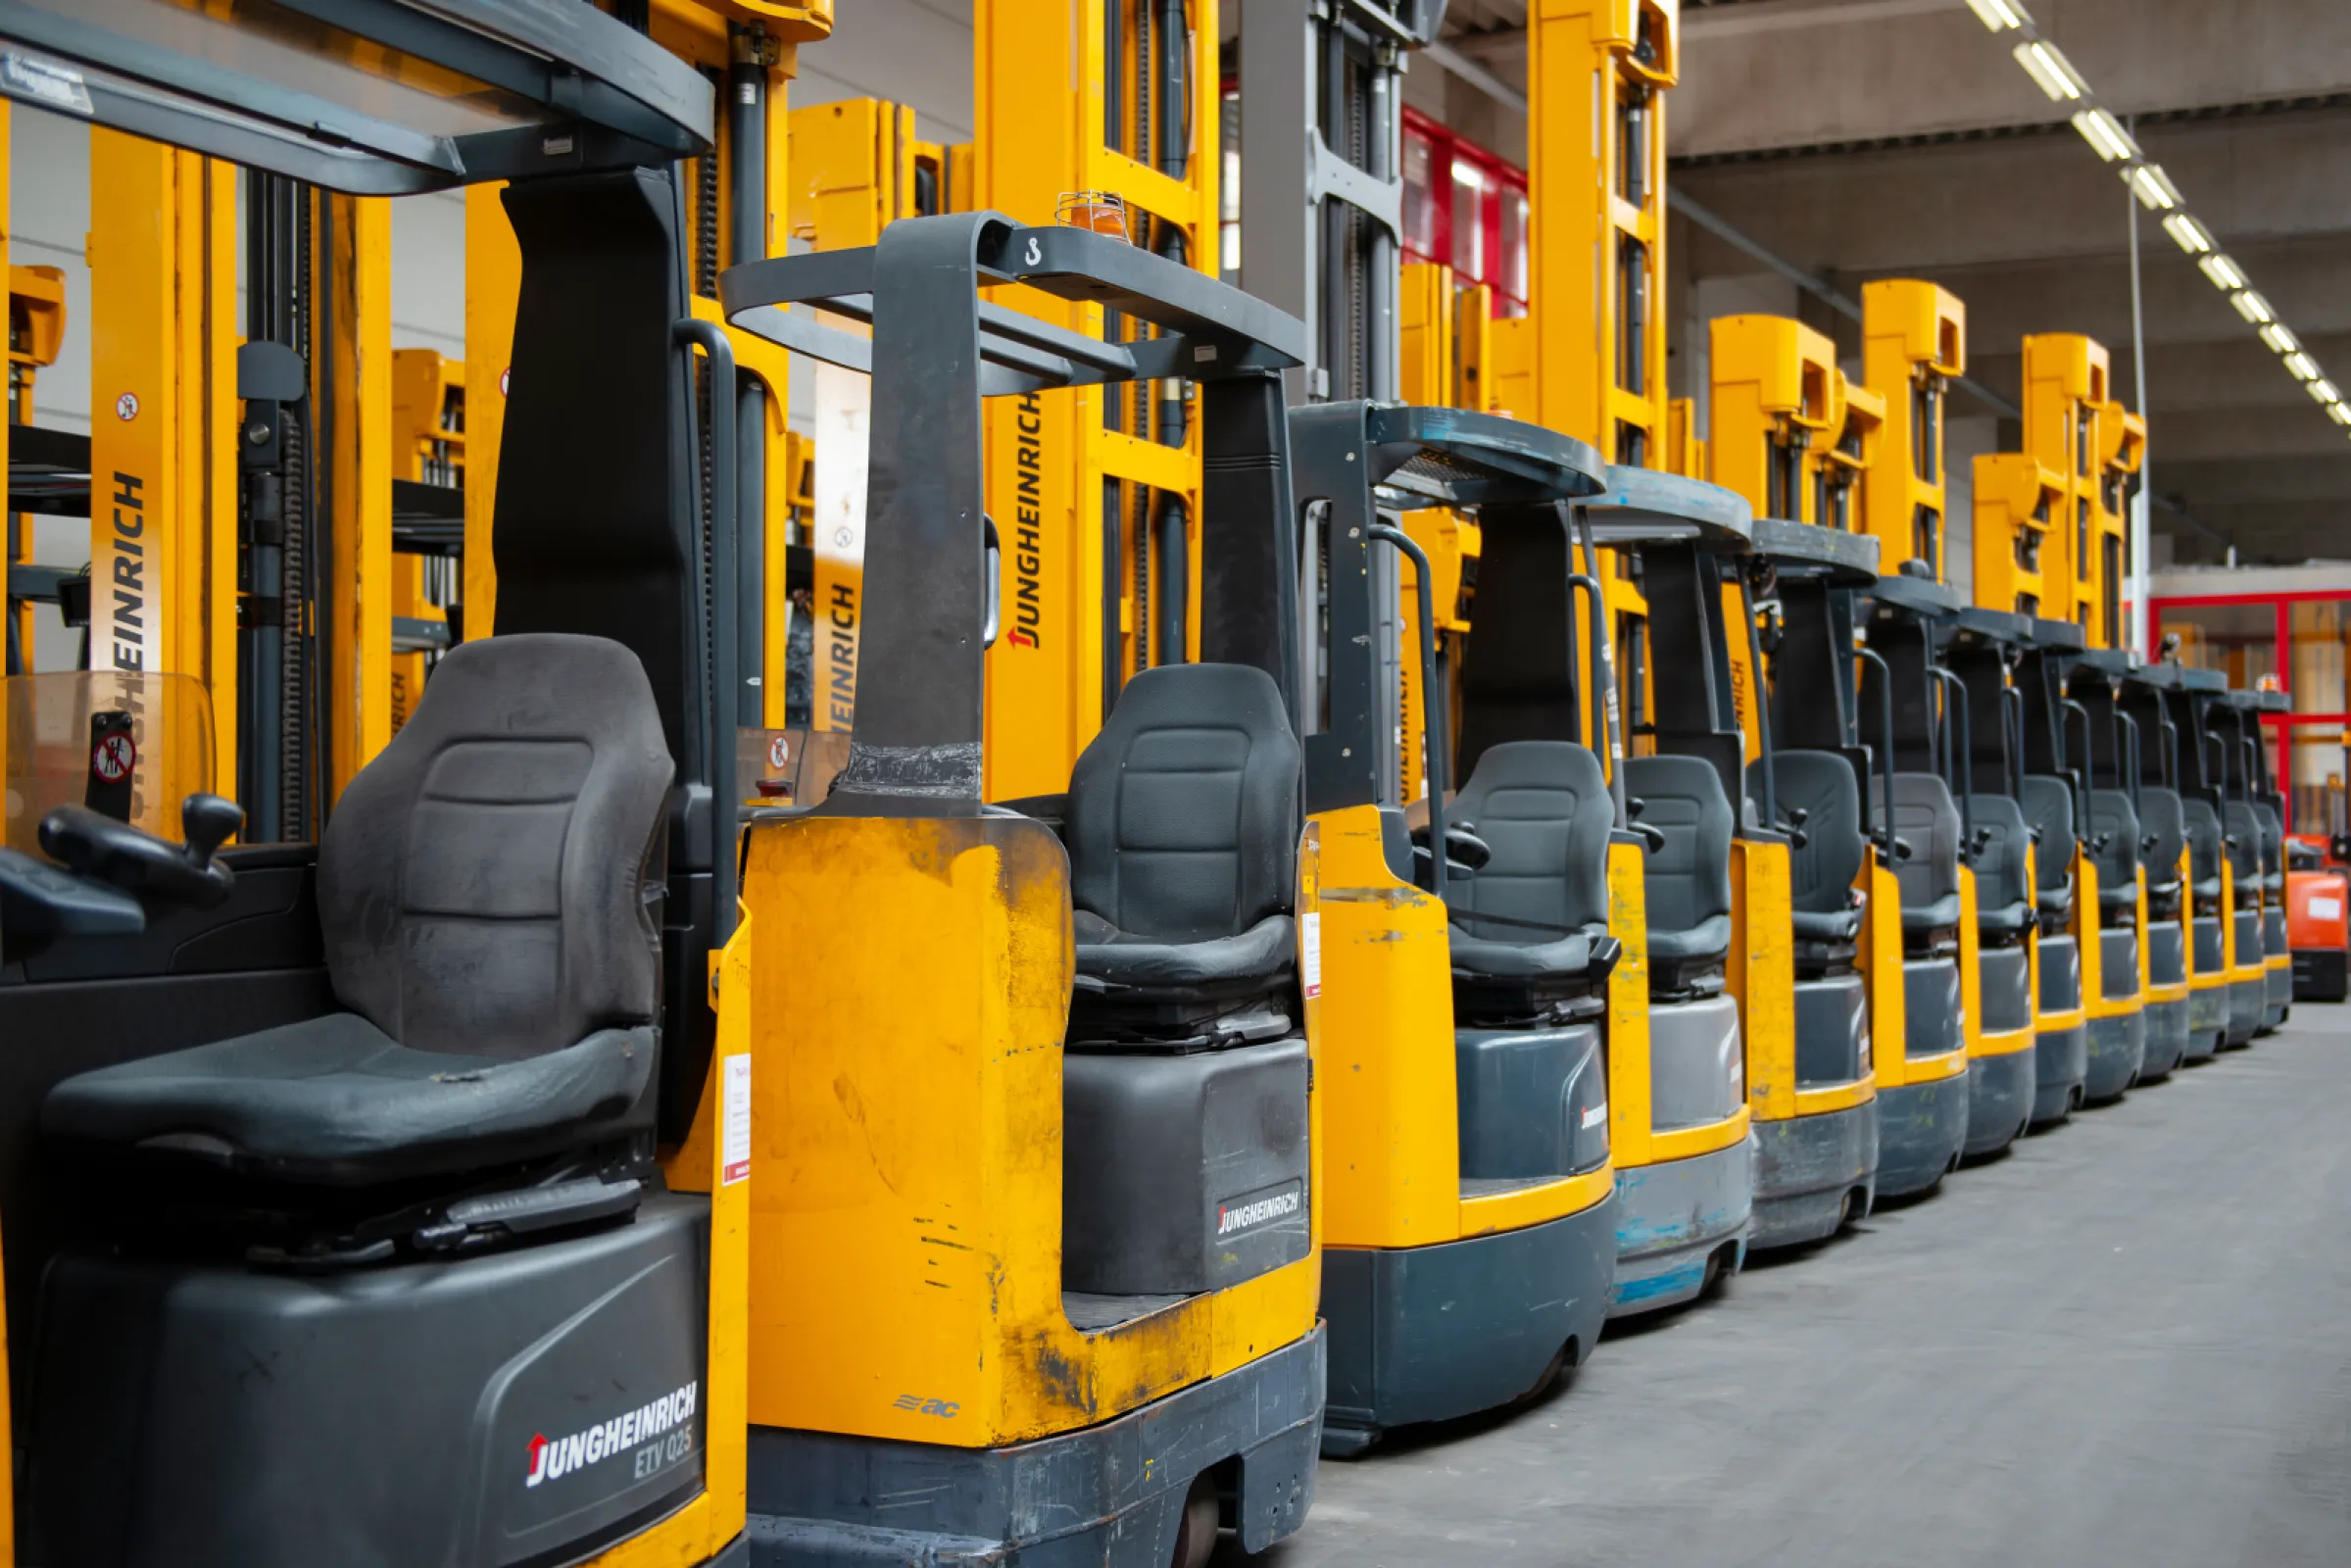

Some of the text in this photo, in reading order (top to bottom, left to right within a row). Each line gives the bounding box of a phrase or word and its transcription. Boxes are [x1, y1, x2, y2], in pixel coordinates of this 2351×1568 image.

[1017, 392, 1041, 649] JUNGHEINRICH
[1218, 1192, 1298, 1235] JUNGHEINRICH
[526, 1380, 697, 1489] JUNGHEINRICH
[634, 1424, 693, 1478] ETV Q25
